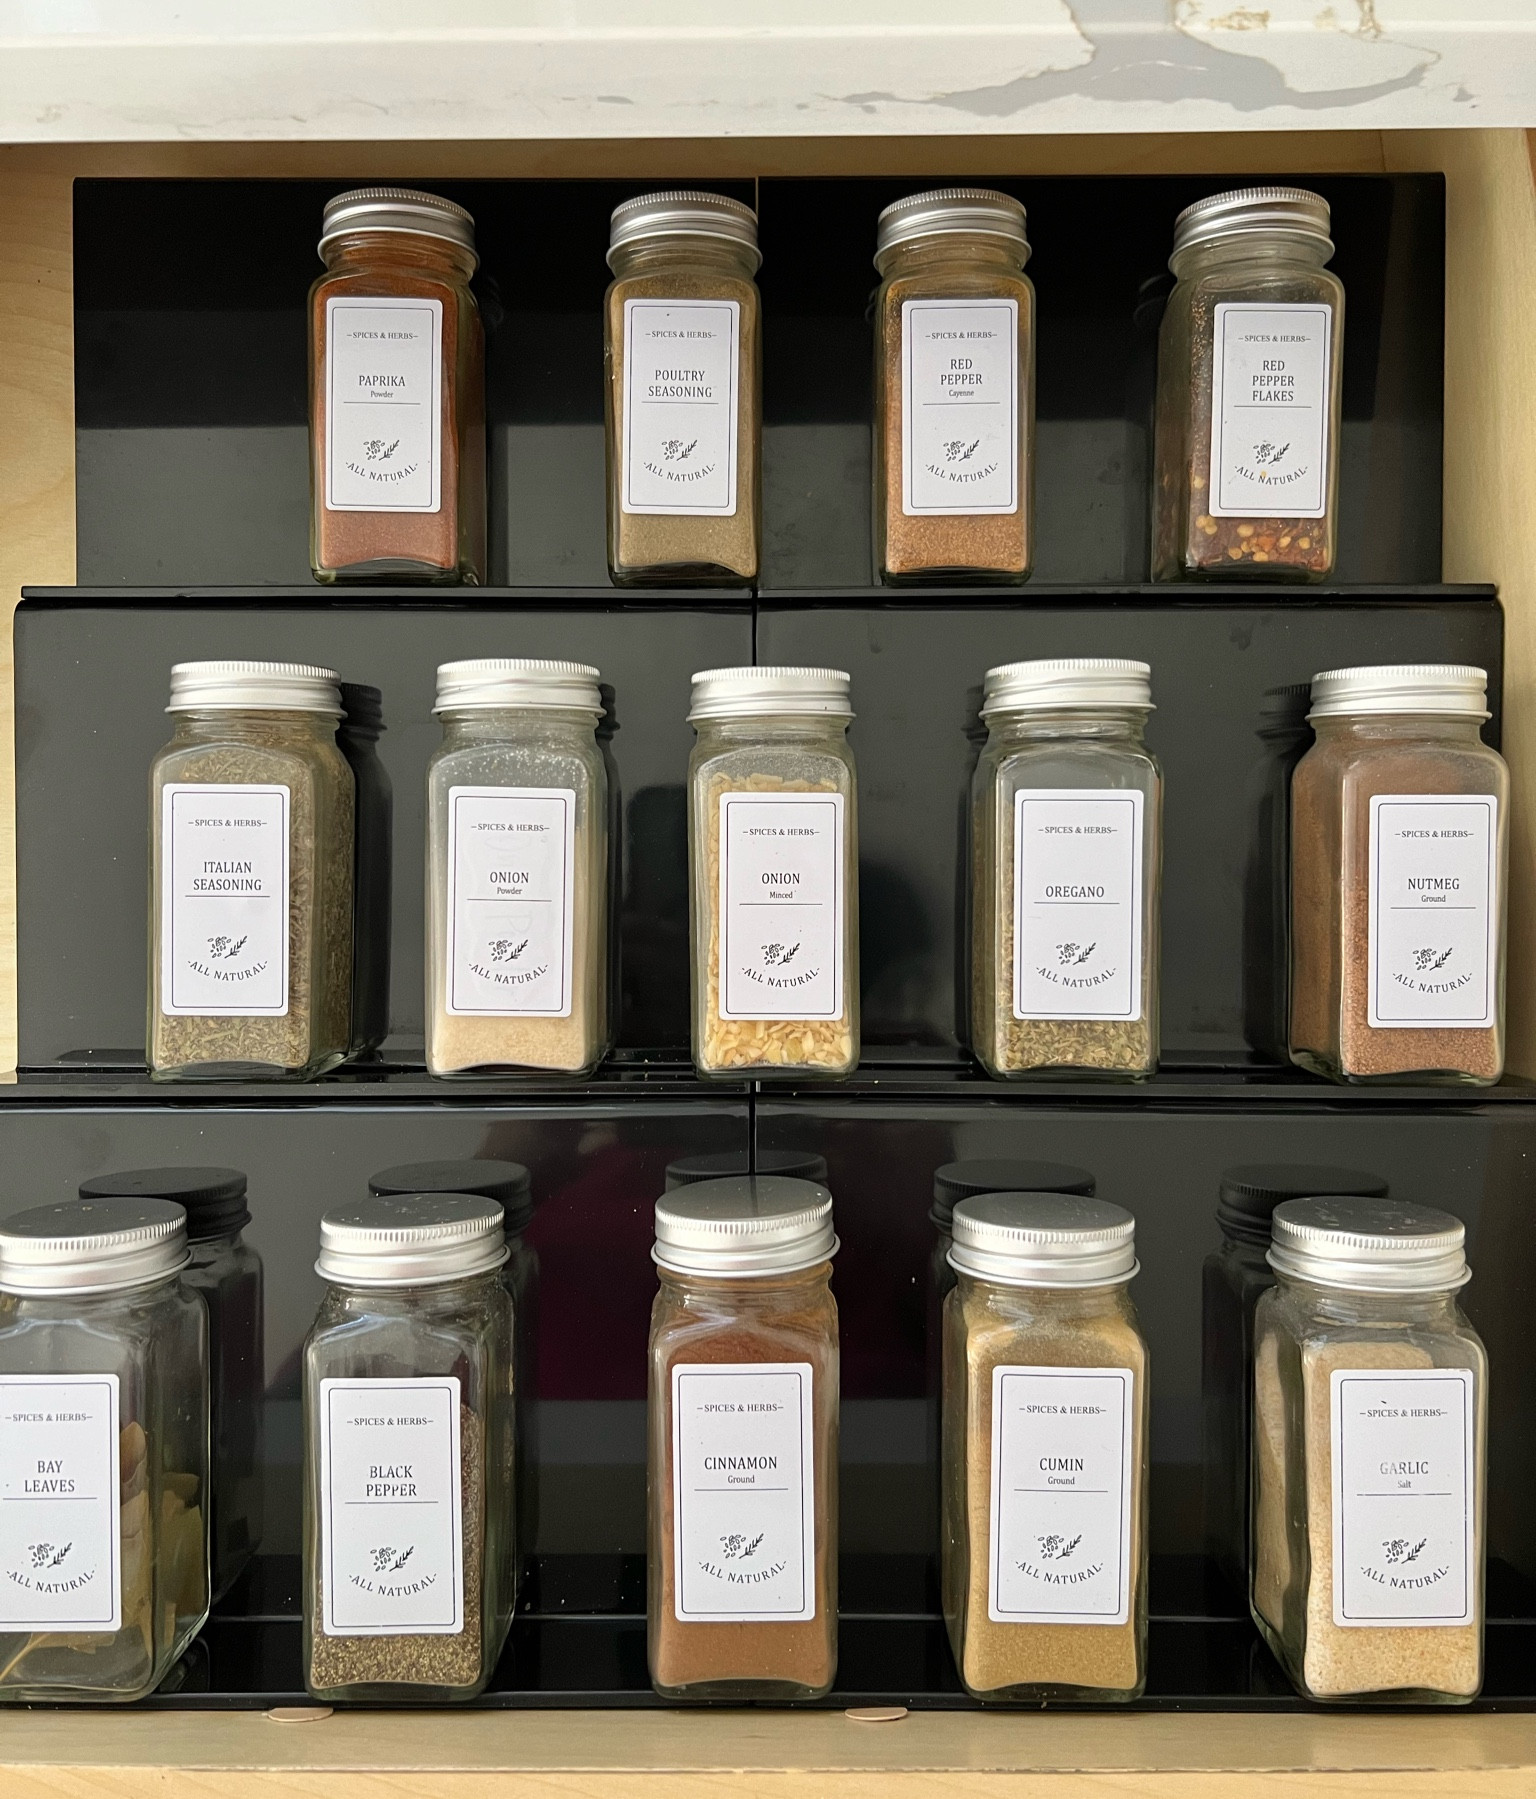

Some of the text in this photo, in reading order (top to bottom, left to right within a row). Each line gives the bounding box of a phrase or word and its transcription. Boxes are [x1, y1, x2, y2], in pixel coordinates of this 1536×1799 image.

[379, 331, 387, 340] &
[678, 330, 686, 339] &
[958, 331, 966, 339] &
[1271, 334, 1279, 343] &
[950, 358, 973, 371] RED
[1262, 359, 1286, 372] RED
[358, 374, 406, 387] PAPRIKA
[654, 369, 706, 382] POULTRY
[940, 373, 983, 386] PEPPER
[1251, 374, 1295, 387] PEPPER
[370, 390, 394, 399] Powder
[647, 385, 712, 398] SEASONING
[948, 388, 975, 399] Cayenne
[1252, 389, 1294, 402] FLAKES
[224, 819, 232, 827] &
[507, 823, 515, 832] &
[778, 828, 786, 836] &
[1074, 826, 1083, 835] &
[1431, 830, 1440, 838] &
[203, 860, 252, 874] ITALIAN
[489, 871, 530, 884] ONION
[761, 872, 801, 885] ONION
[193, 878, 262, 891] SEASONING
[1407, 877, 1460, 891] NUTMEG
[496, 886, 523, 895] Powder
[769, 890, 794, 900] Minced
[1045, 885, 1105, 898] OREGANO
[1420, 894, 1447, 903] Ground
[736, 1403, 745, 1413] &
[1059, 1405, 1068, 1415] &
[1400, 1408, 1409, 1418] &
[45, 1413, 54, 1422] &
[386, 1417, 395, 1426] &
[37, 1459, 64, 1474] BAY
[703, 1455, 778, 1471] CINNAMON
[1039, 1457, 1084, 1472] CUMIN
[1379, 1461, 1429, 1475] GARLIC
[369, 1464, 414, 1479] BLACK
[727, 1473, 756, 1484] Ground
[1047, 1475, 1076, 1486] Ground
[1397, 1479, 1412, 1489] Salt
[24, 1478, 75, 1493] LEAVES
[365, 1483, 418, 1497] PEPPER
